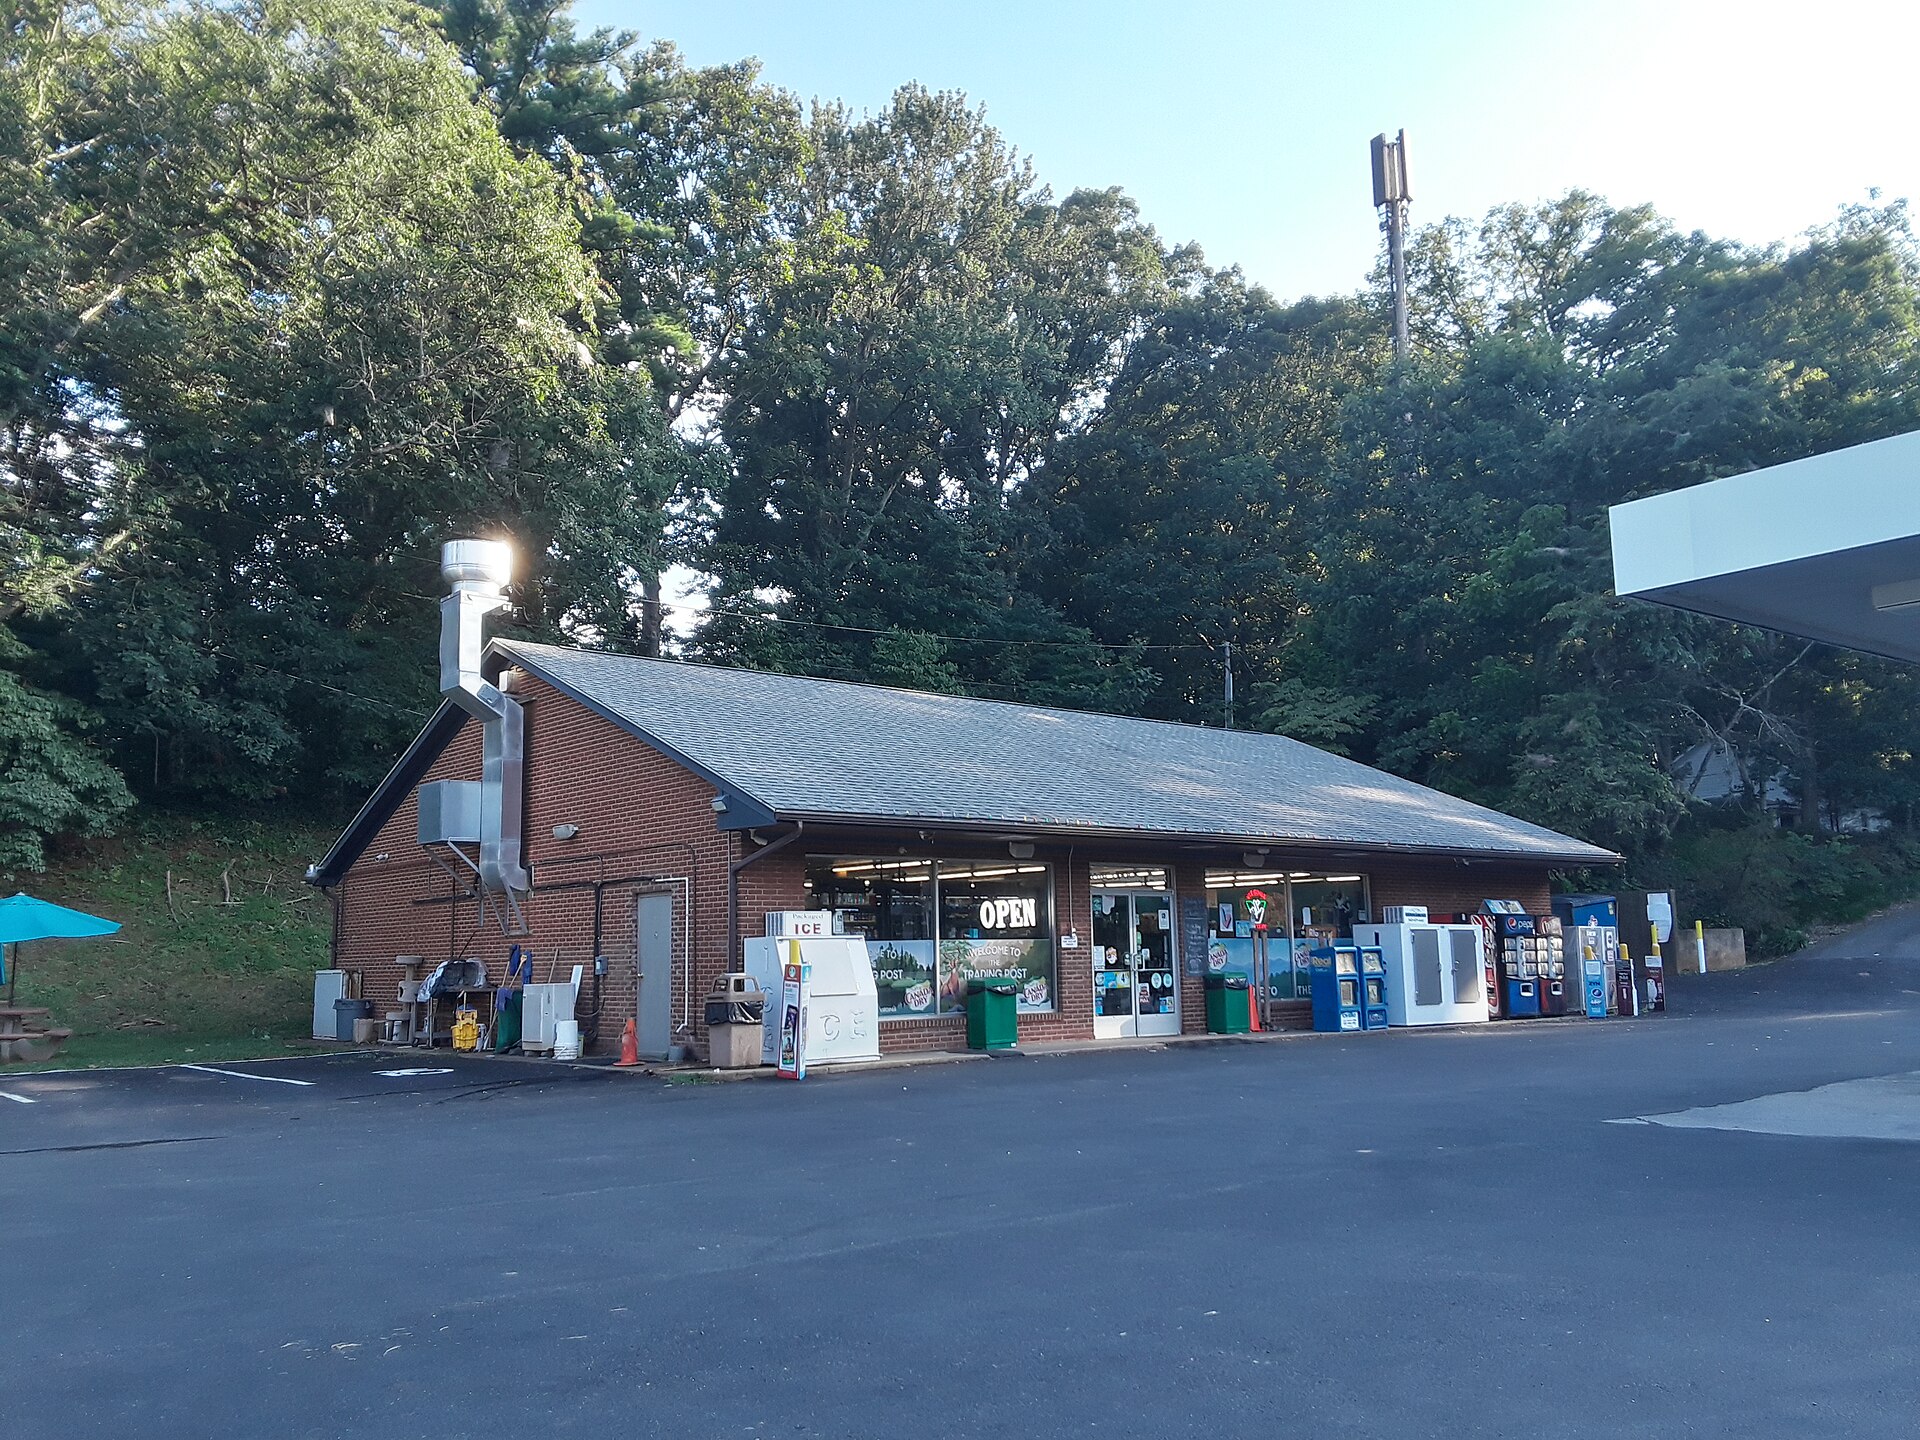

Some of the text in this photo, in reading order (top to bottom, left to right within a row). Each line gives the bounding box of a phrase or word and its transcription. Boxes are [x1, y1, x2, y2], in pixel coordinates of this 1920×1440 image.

[980, 899, 1036, 929] OPEN
[794, 923, 822, 935] ICE
[887, 949, 898, 959] TO
[966, 946, 1021, 958] WELCOME TO
[880, 969, 904, 980] POST
[963, 968, 1028, 980] TRADING POST
[1297, 985, 1312, 996] THE
[913, 994, 928, 1007] DRY
